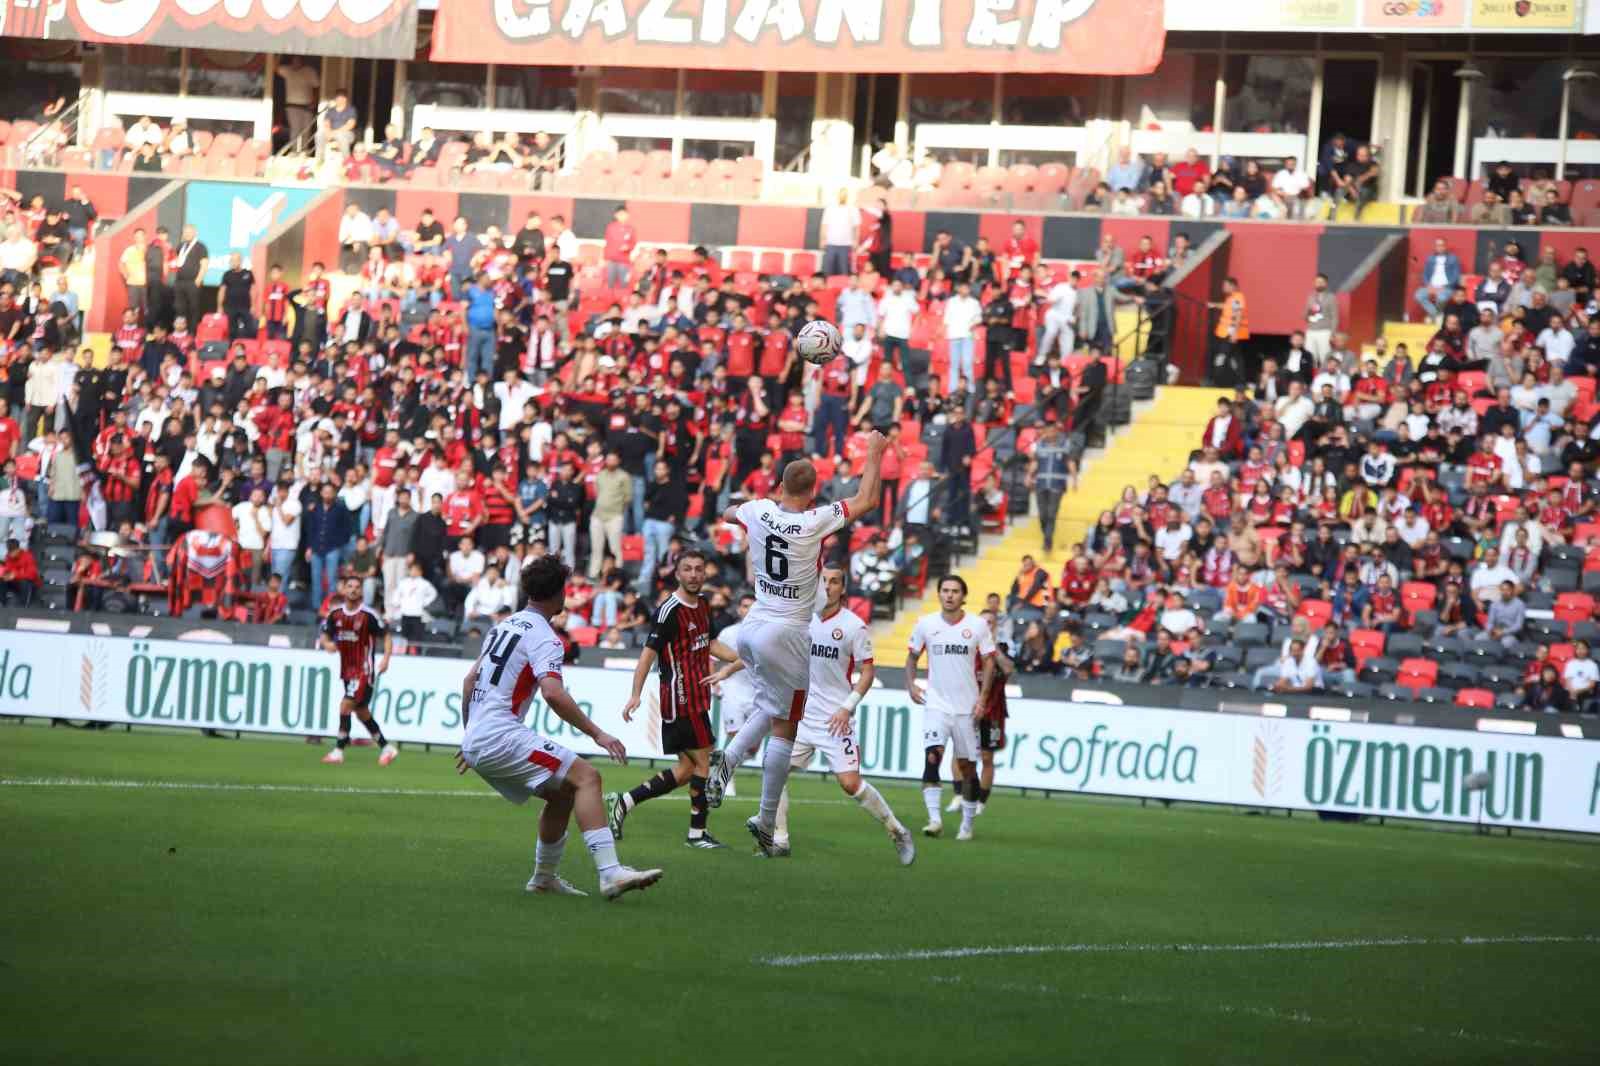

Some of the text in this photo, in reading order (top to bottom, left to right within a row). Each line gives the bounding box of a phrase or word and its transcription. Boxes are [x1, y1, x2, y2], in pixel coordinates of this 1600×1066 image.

[766, 534, 789, 582] 6
[811, 643, 839, 660] ARCA
[944, 644, 969, 656] ARCA
[370, 670, 436, 726] her
[1035, 724, 1198, 791] sofrada
